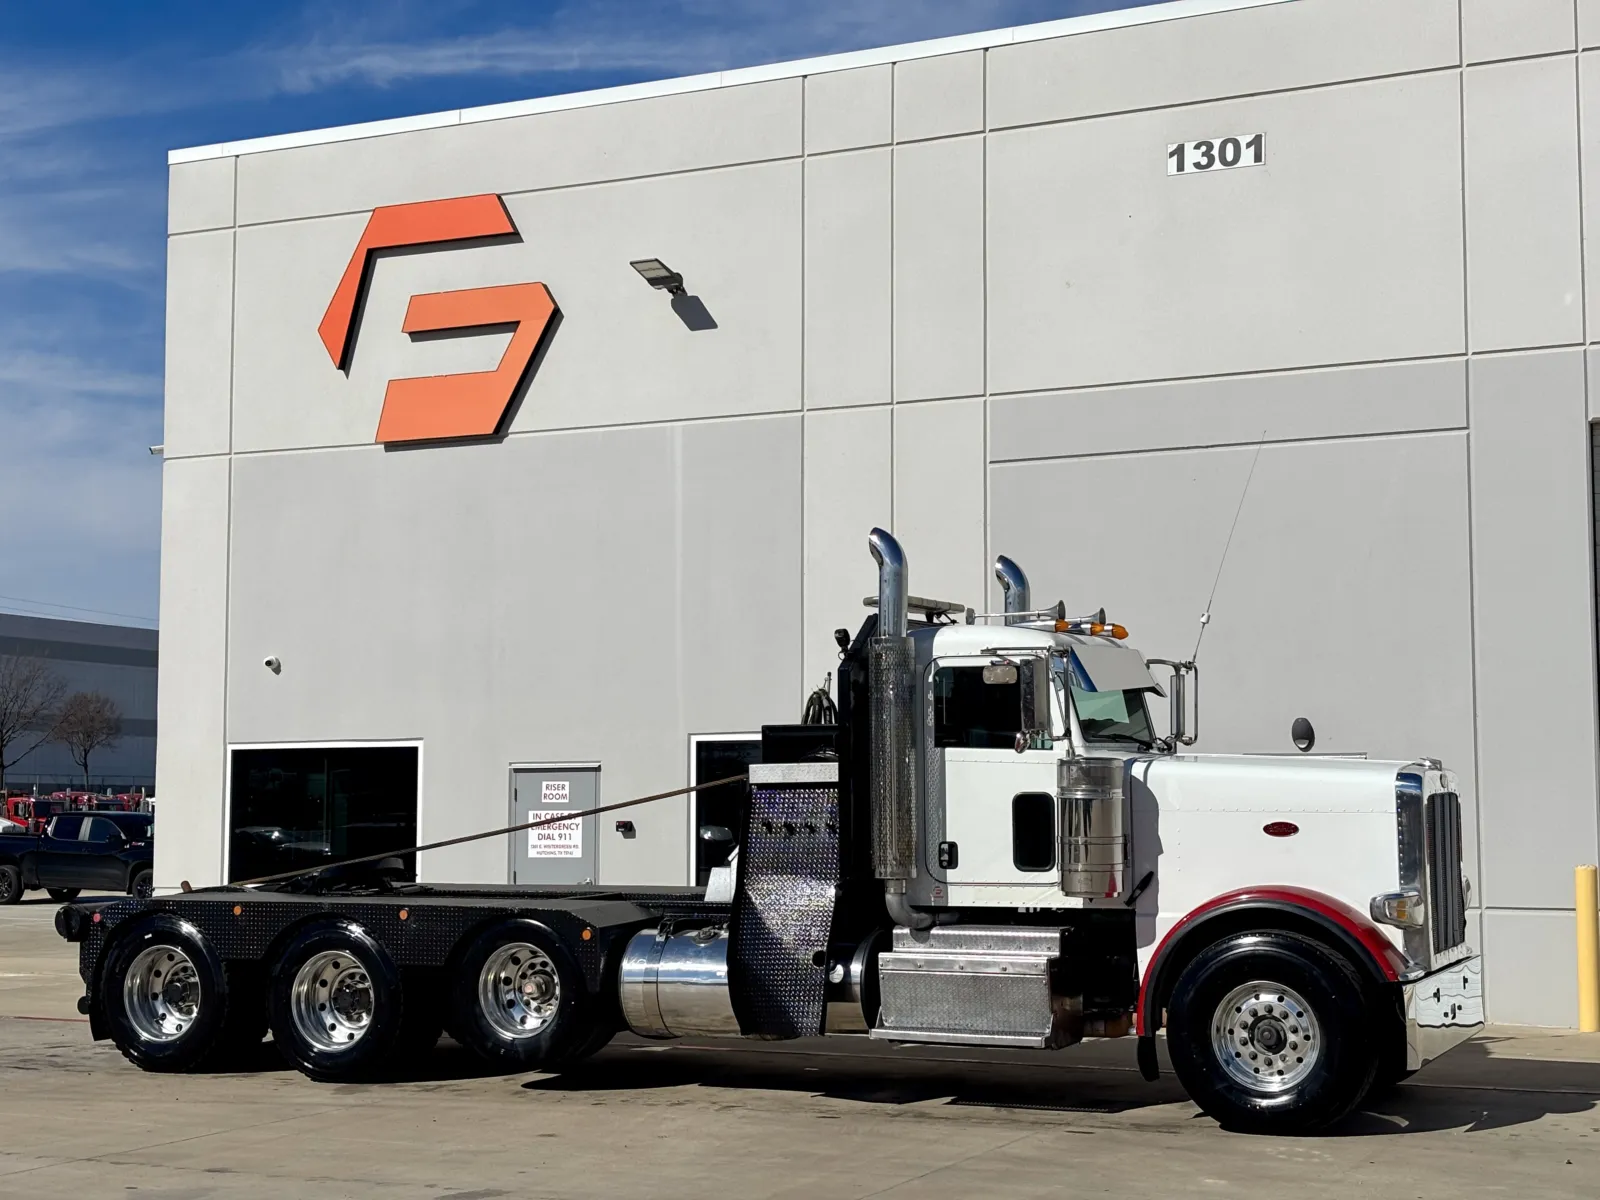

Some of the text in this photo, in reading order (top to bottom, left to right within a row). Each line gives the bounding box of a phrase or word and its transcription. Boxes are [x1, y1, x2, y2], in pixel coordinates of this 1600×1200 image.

[1168, 133, 1263, 173] 1301
[545, 783, 566, 791] RISER
[532, 812, 542, 820] IN
[537, 833, 572, 841] DIAL 911
